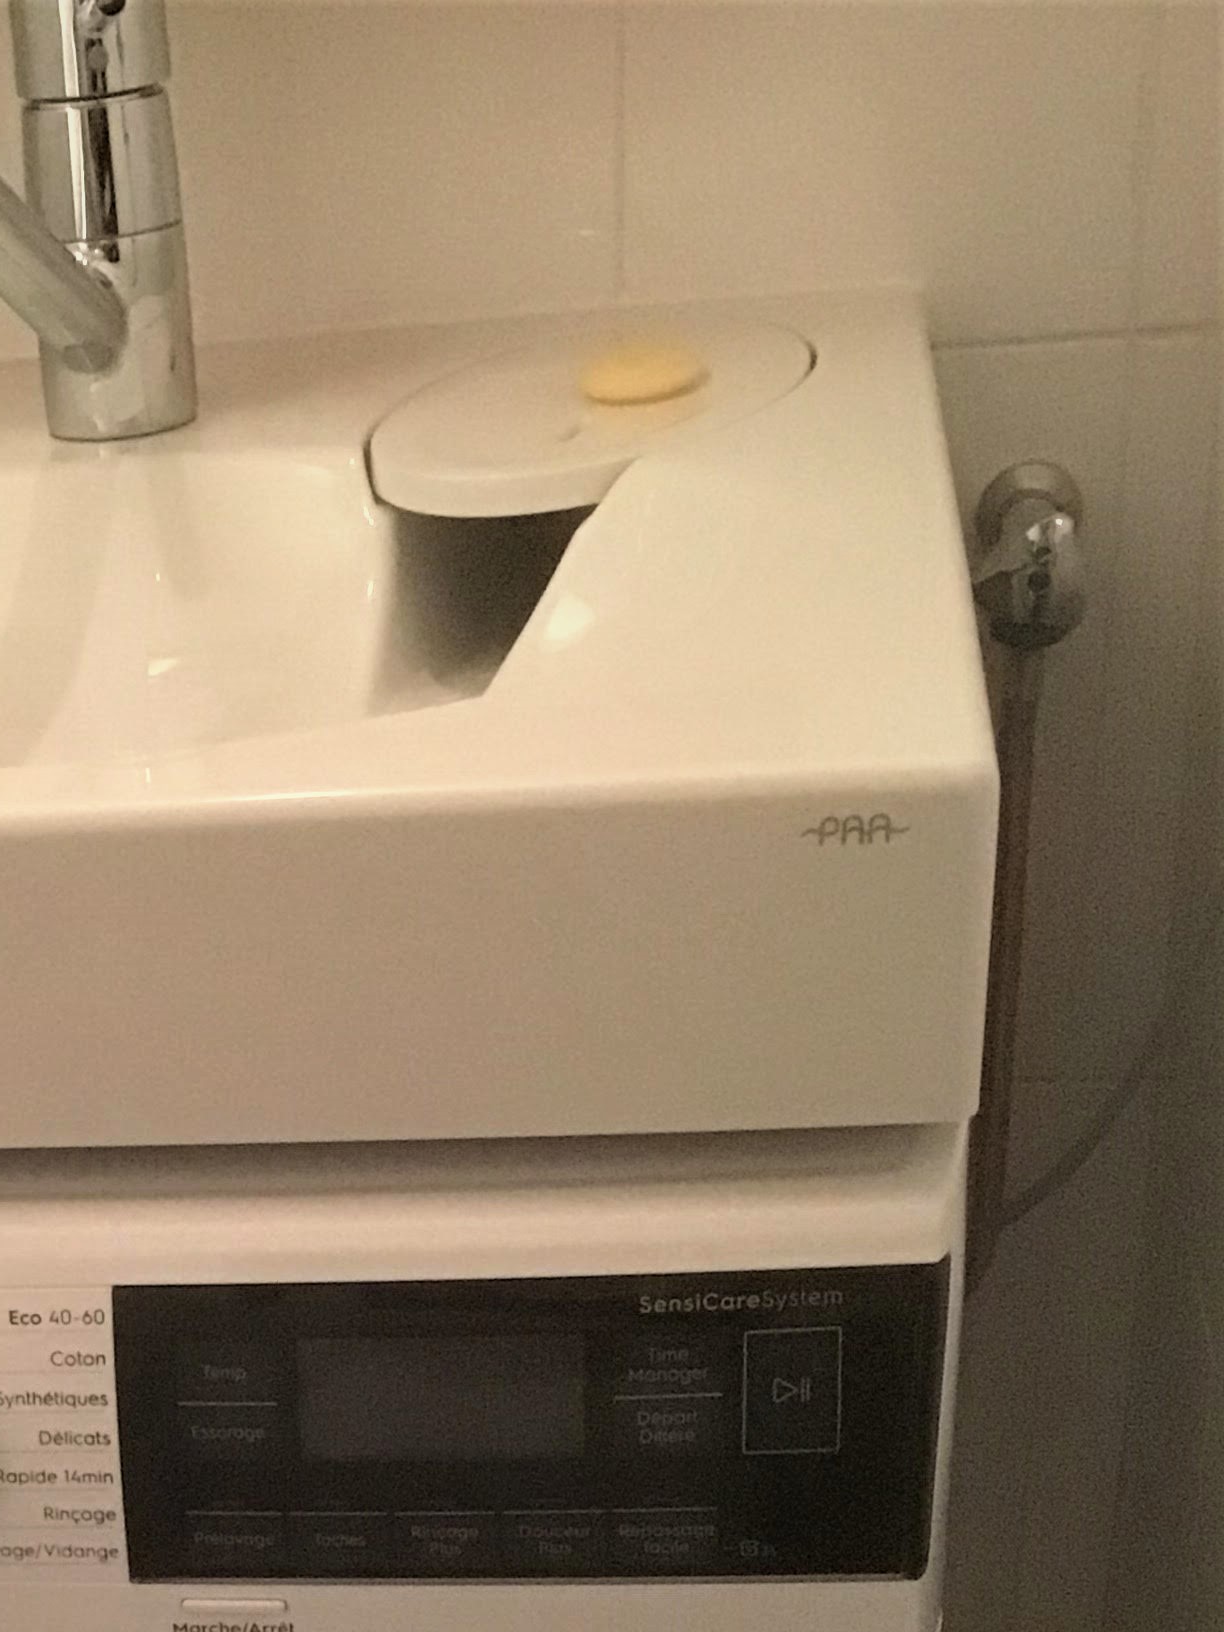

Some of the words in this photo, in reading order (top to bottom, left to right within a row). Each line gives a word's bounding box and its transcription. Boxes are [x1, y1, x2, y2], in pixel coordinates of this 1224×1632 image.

[638, 1288, 844, 1315] SensiCareSystem
[8, 1309, 42, 1326] Eco
[49, 1308, 105, 1326] 40-60
[49, 1350, 106, 1367] Coton
[38, 1430, 112, 1447] Délicats
[63, 1469, 114, 1485] 14min
[43, 1506, 118, 1524] Rinçage
